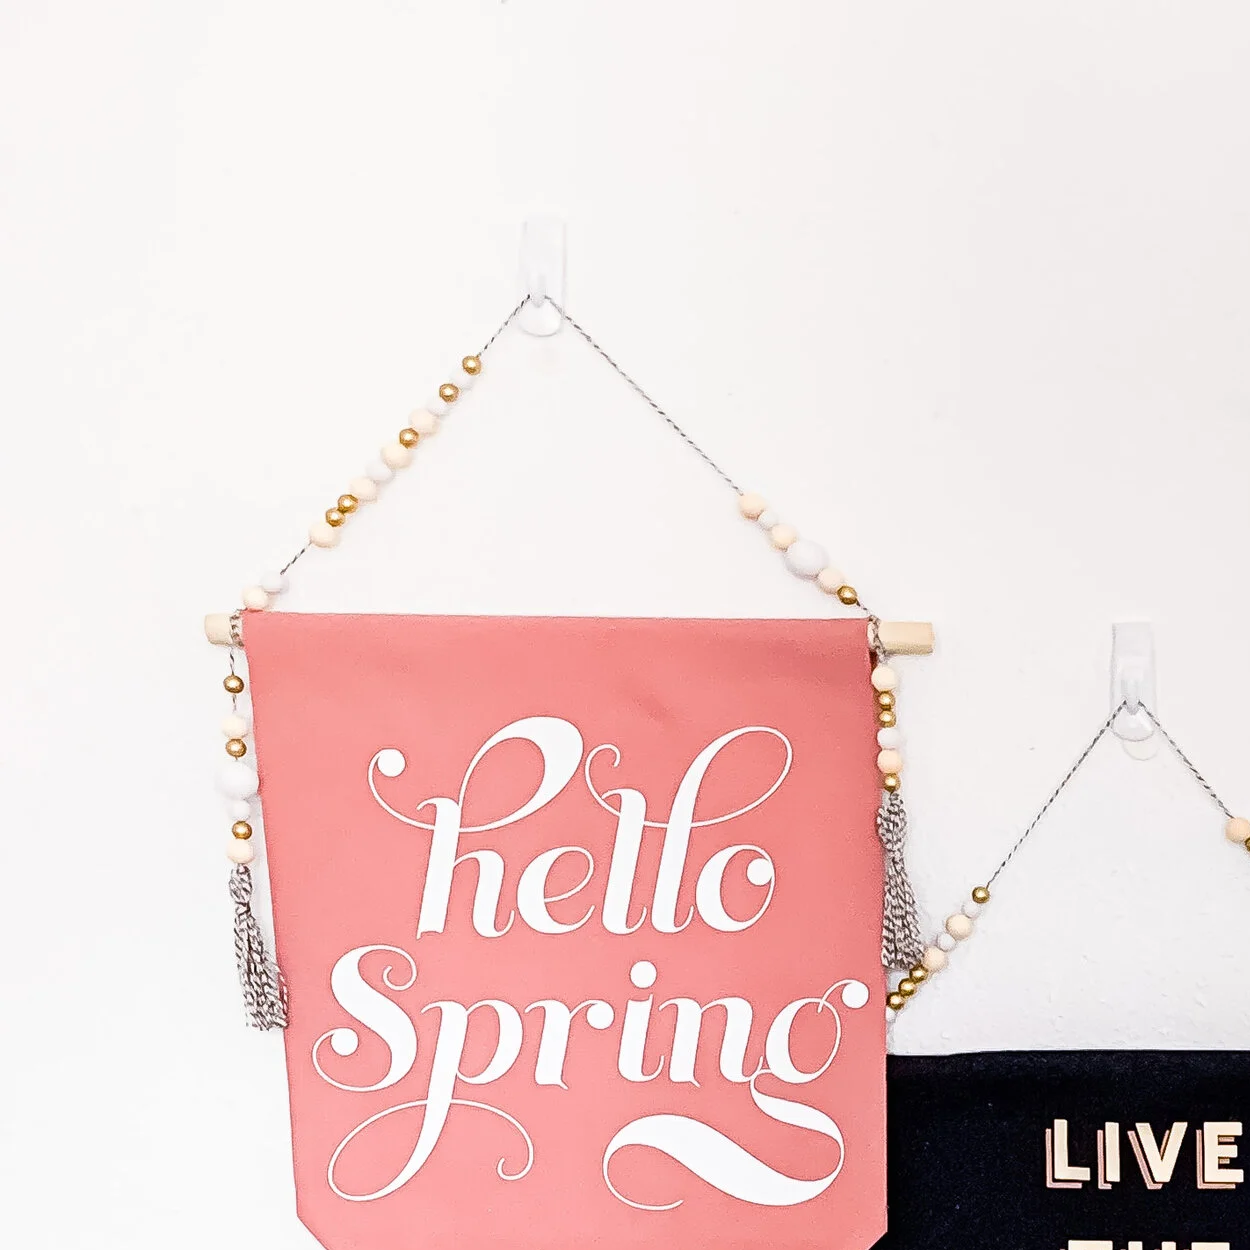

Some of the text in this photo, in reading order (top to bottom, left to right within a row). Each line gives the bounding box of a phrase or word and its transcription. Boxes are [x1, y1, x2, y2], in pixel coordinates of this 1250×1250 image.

[367, 715, 793, 939] hello
[311, 944, 870, 1211] Spring
[1045, 1119, 1244, 1189] LIVE
